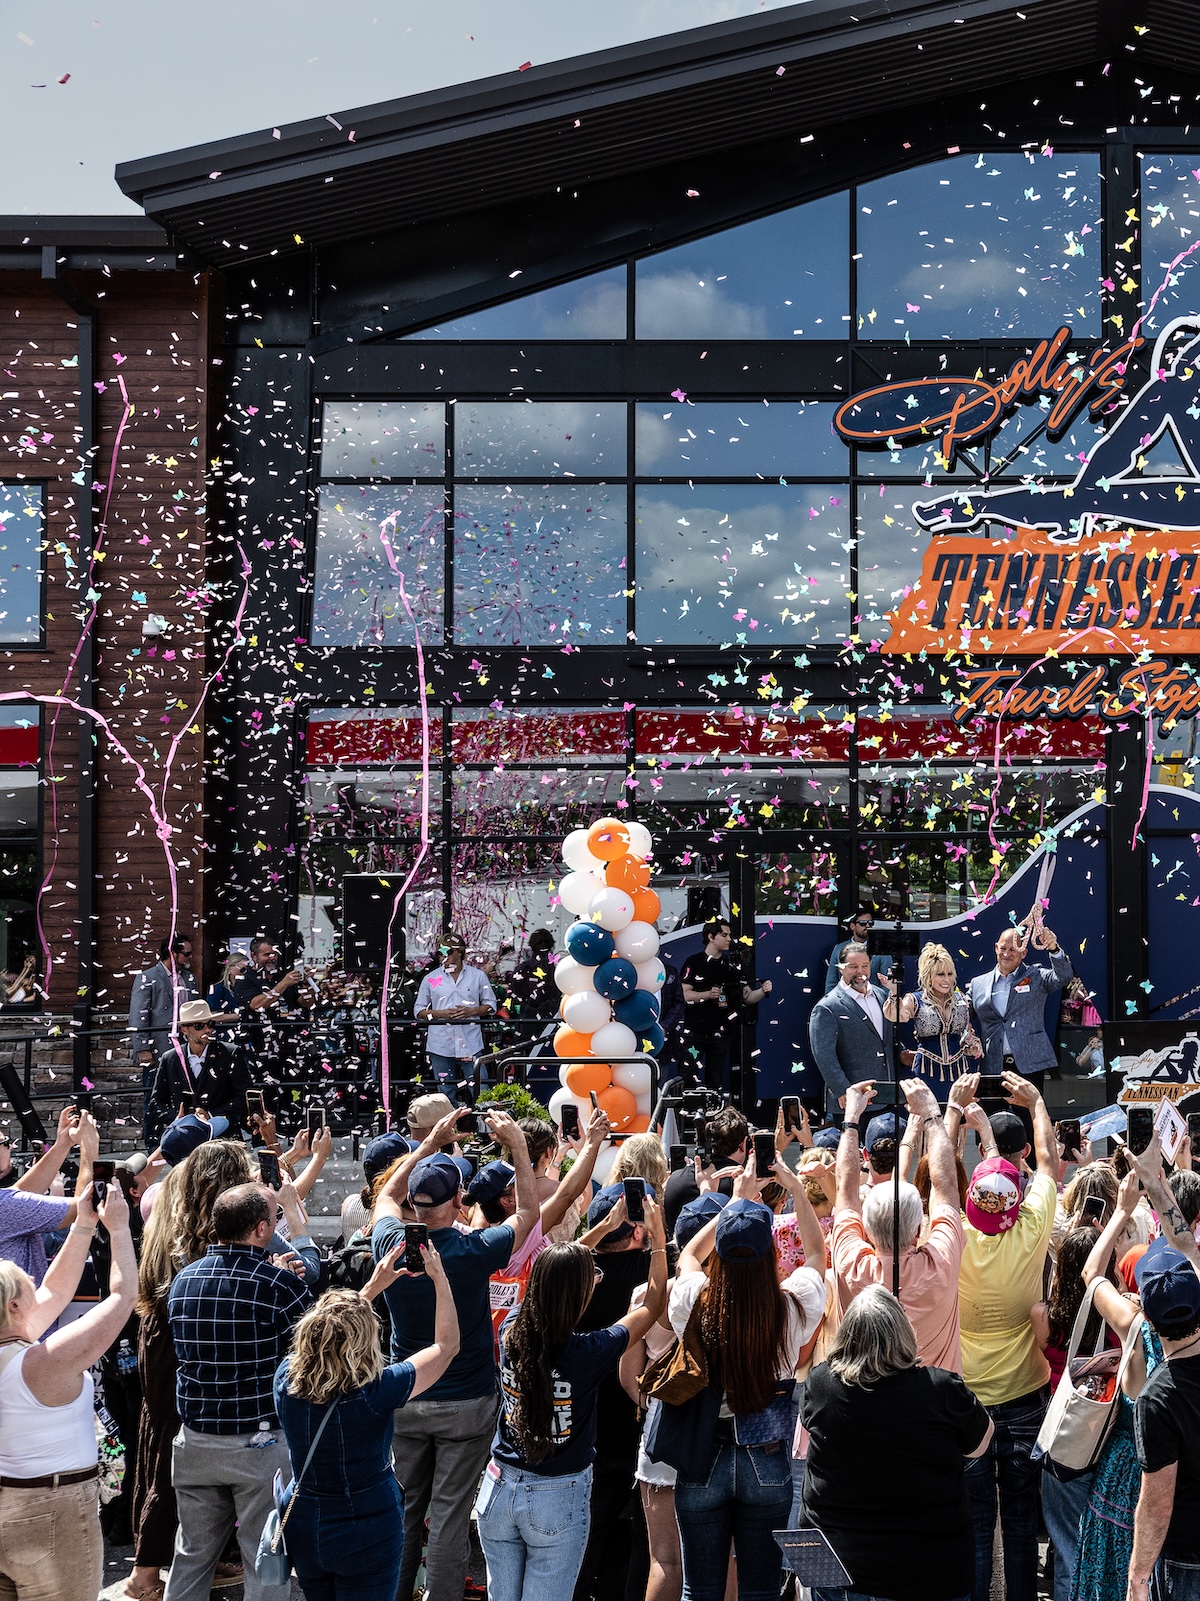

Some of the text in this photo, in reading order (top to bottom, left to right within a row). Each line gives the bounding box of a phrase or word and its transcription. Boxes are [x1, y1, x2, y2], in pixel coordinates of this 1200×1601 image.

[835, 326, 1146, 464] Dolly's
[954, 665, 1106, 721] Travel
[1127, 1086, 1180, 1099] TENNESSEAN
